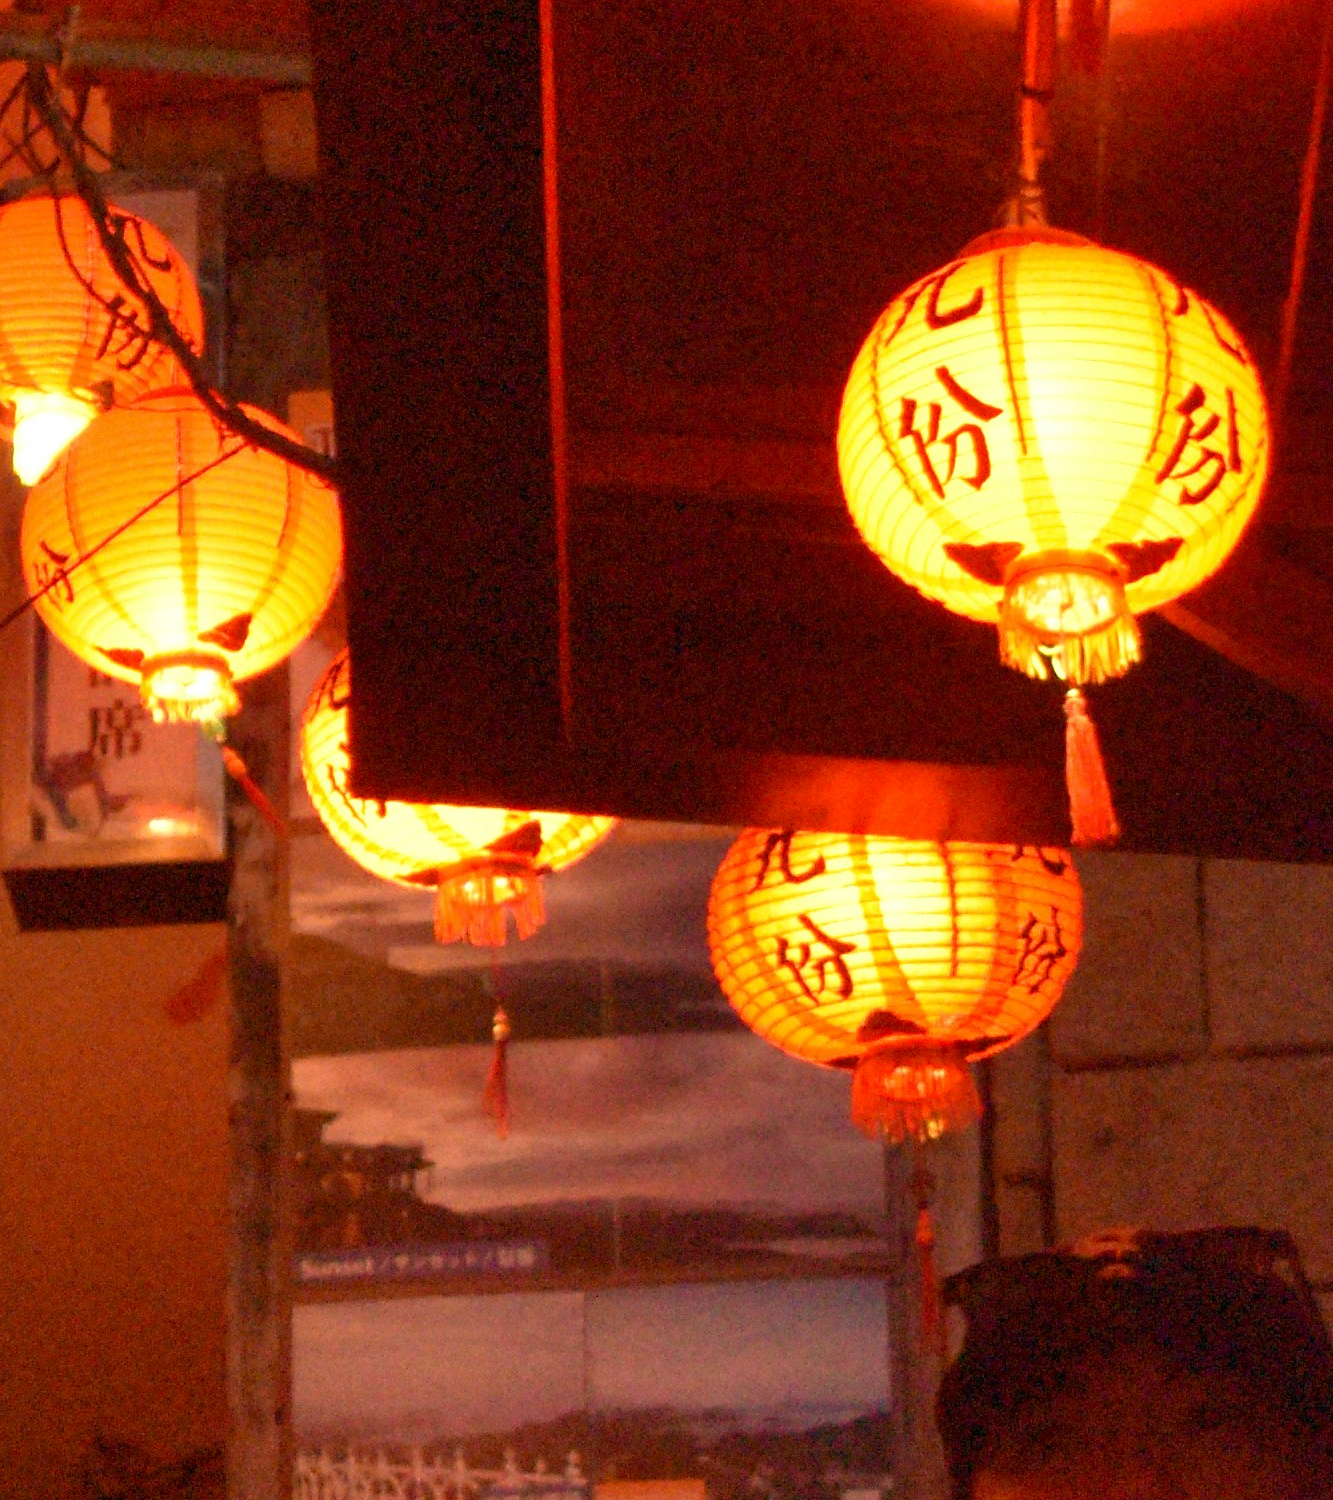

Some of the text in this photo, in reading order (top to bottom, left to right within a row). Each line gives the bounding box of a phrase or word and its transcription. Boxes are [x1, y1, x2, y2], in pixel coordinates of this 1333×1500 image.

[883, 262, 1003, 500] 九份
[1156, 287, 1248, 506] 九份
[749, 830, 857, 1006] 九份
